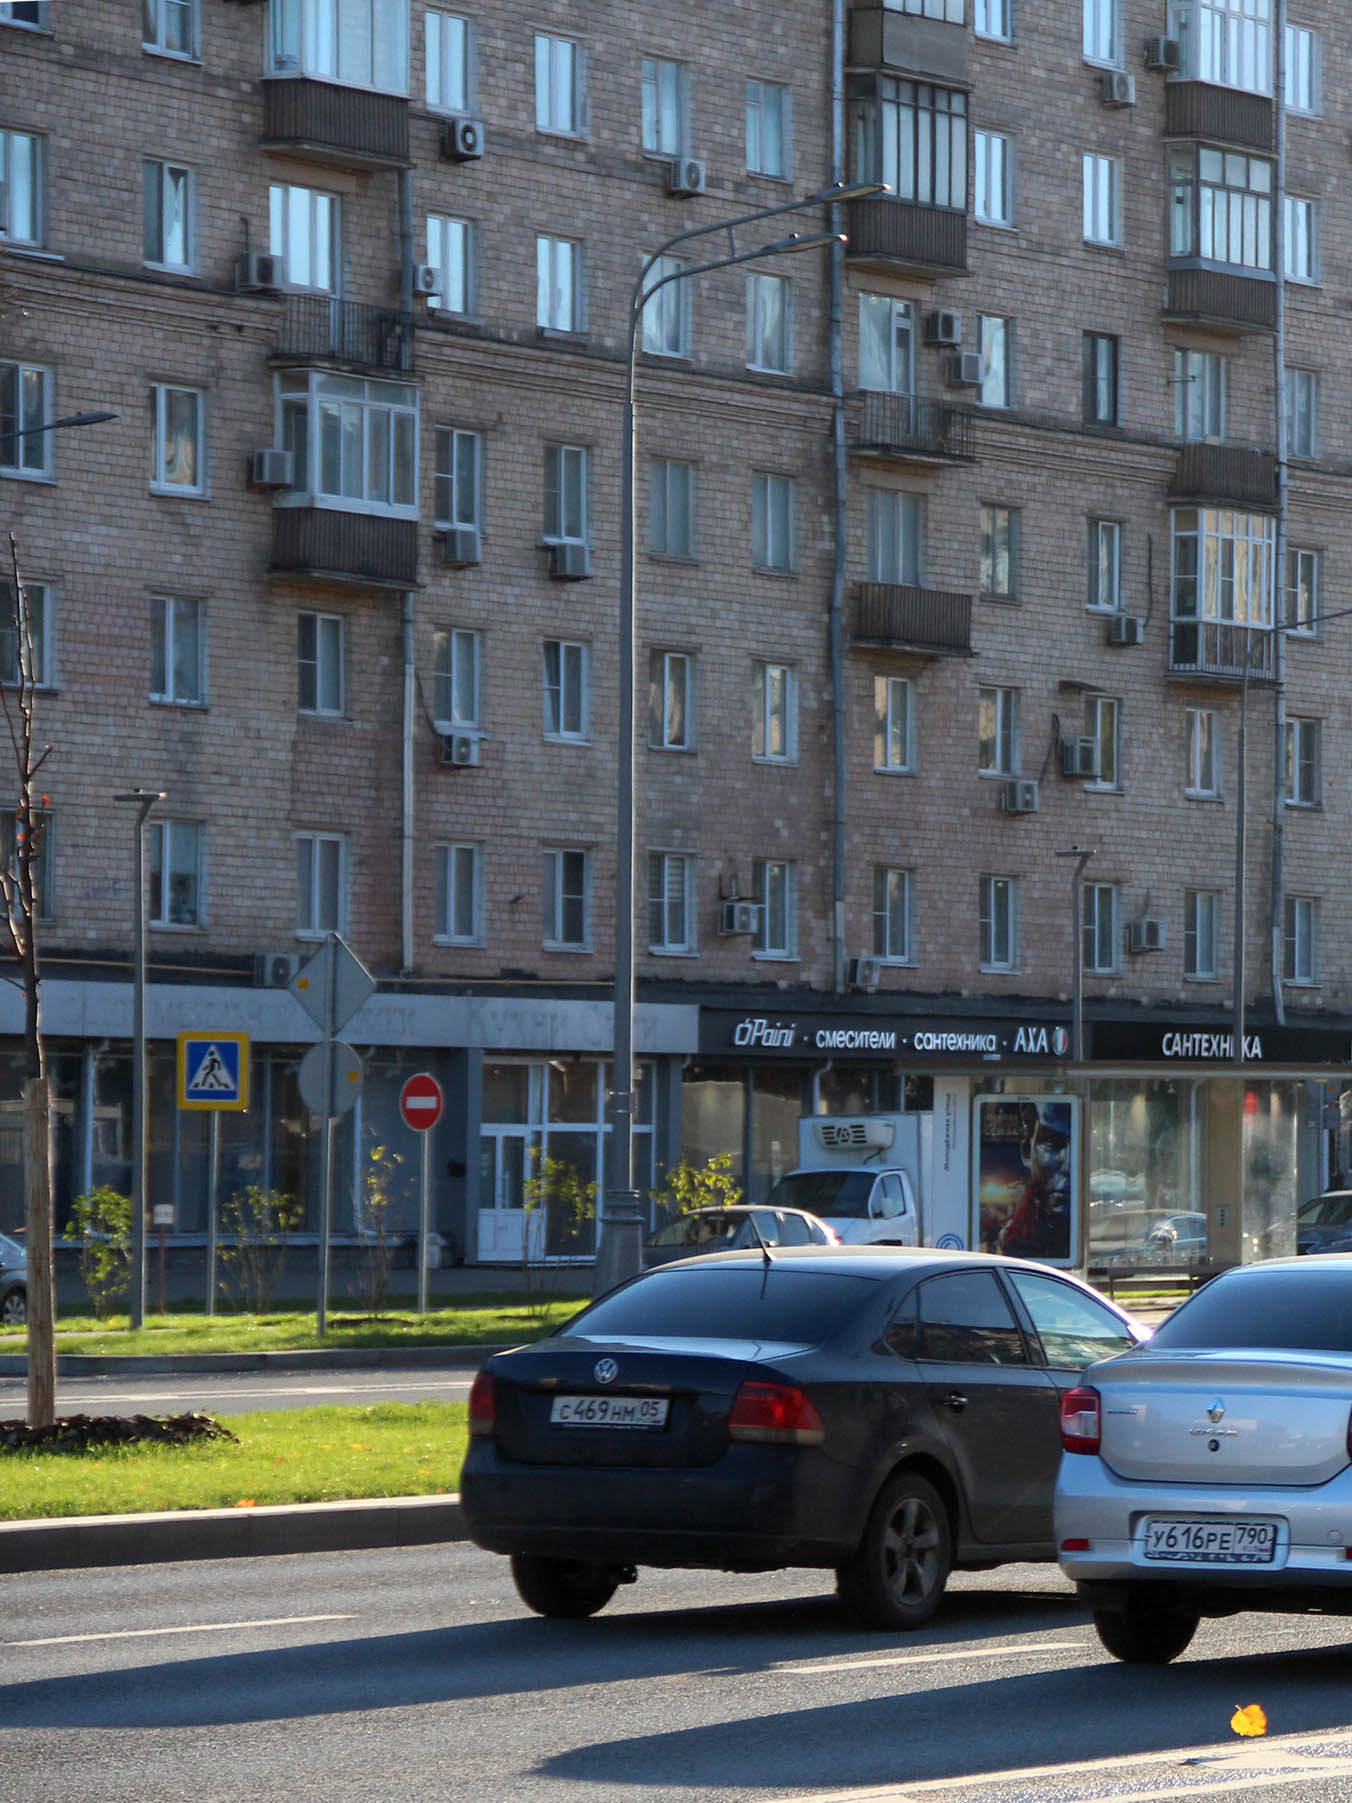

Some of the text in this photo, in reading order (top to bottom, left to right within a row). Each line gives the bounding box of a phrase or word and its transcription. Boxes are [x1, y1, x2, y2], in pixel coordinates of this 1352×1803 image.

[752, 1019, 796, 1047] Paini
[816, 1030, 996, 1051] смесители сантехника
[1162, 1032, 1262, 1058] САНТЕХНКА
[640, 1401, 661, 1417] 05
[1237, 1526, 1268, 1545] 790
